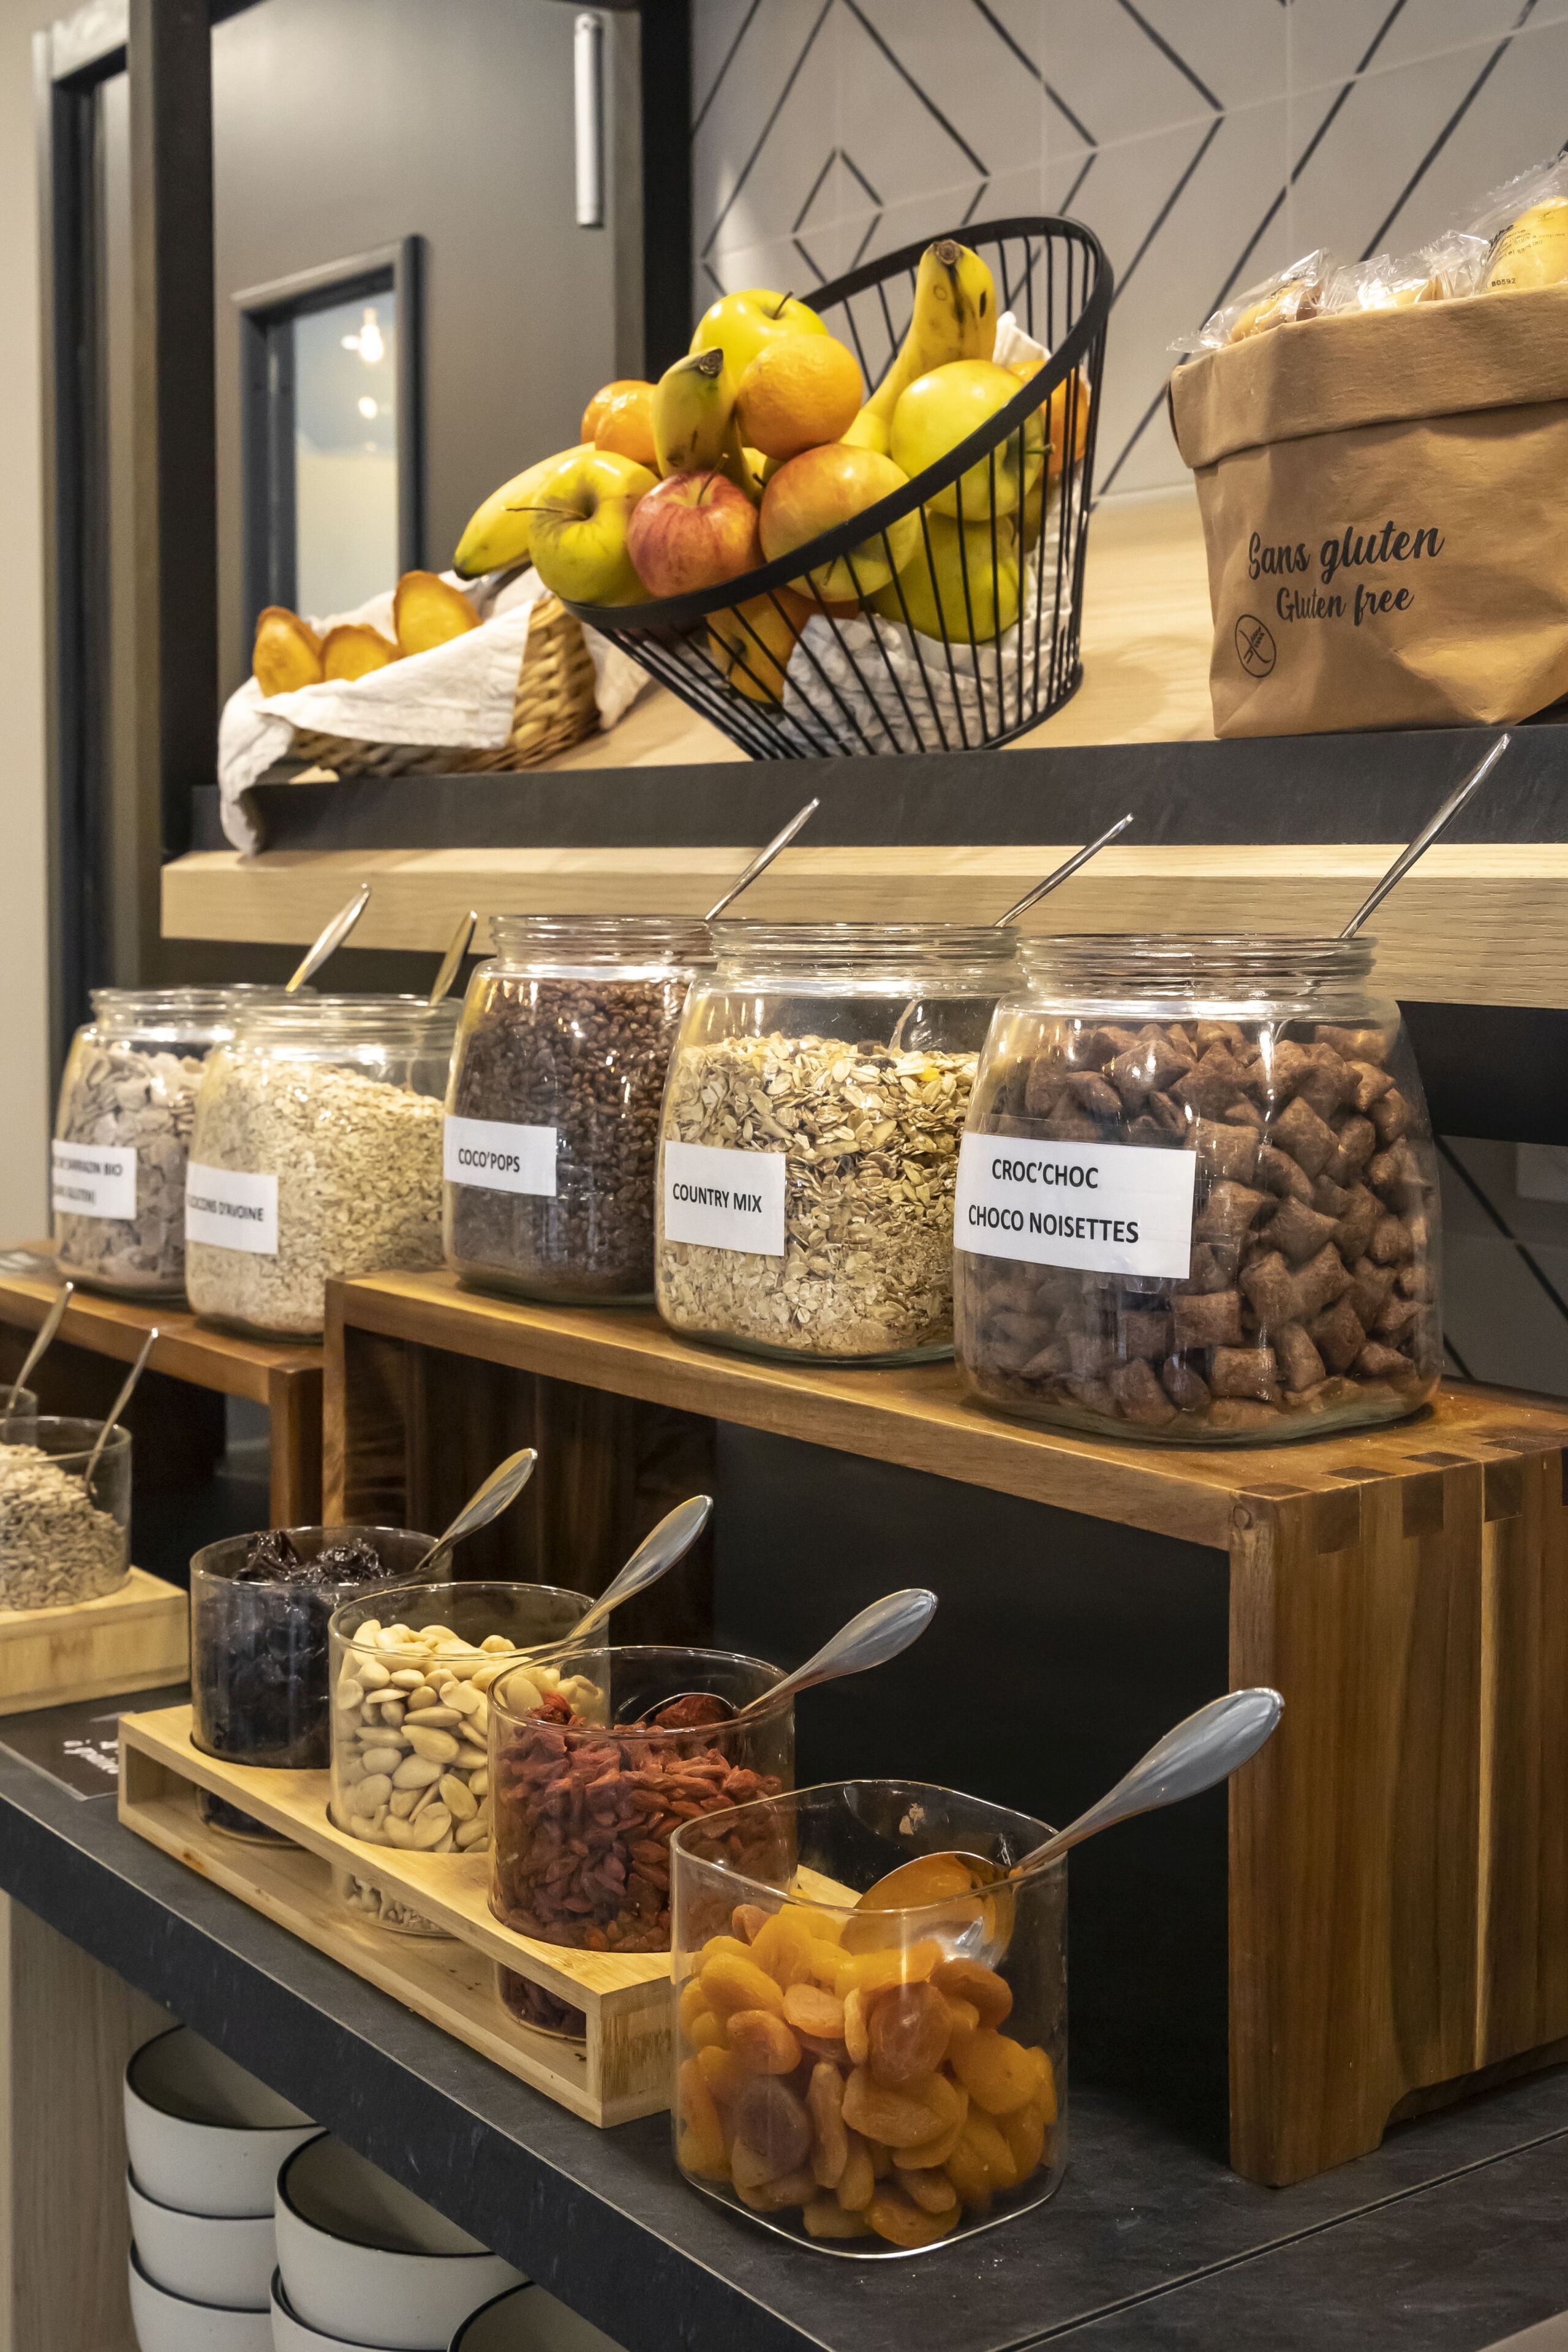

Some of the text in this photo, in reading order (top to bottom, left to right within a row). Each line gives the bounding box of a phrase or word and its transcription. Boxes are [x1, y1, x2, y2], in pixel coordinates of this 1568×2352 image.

[1249, 520, 1446, 584] Sans gluten
[1276, 584, 1415, 627] Gluten free
[104, 1162, 124, 1177] BIO
[458, 1148, 521, 1173] COCO'POPS
[992, 1158, 1099, 1189] CROC'CHOC
[673, 1183, 763, 1213] COUNTRY MIX
[968, 1204, 1139, 1243] CHOCO NOISETTES
